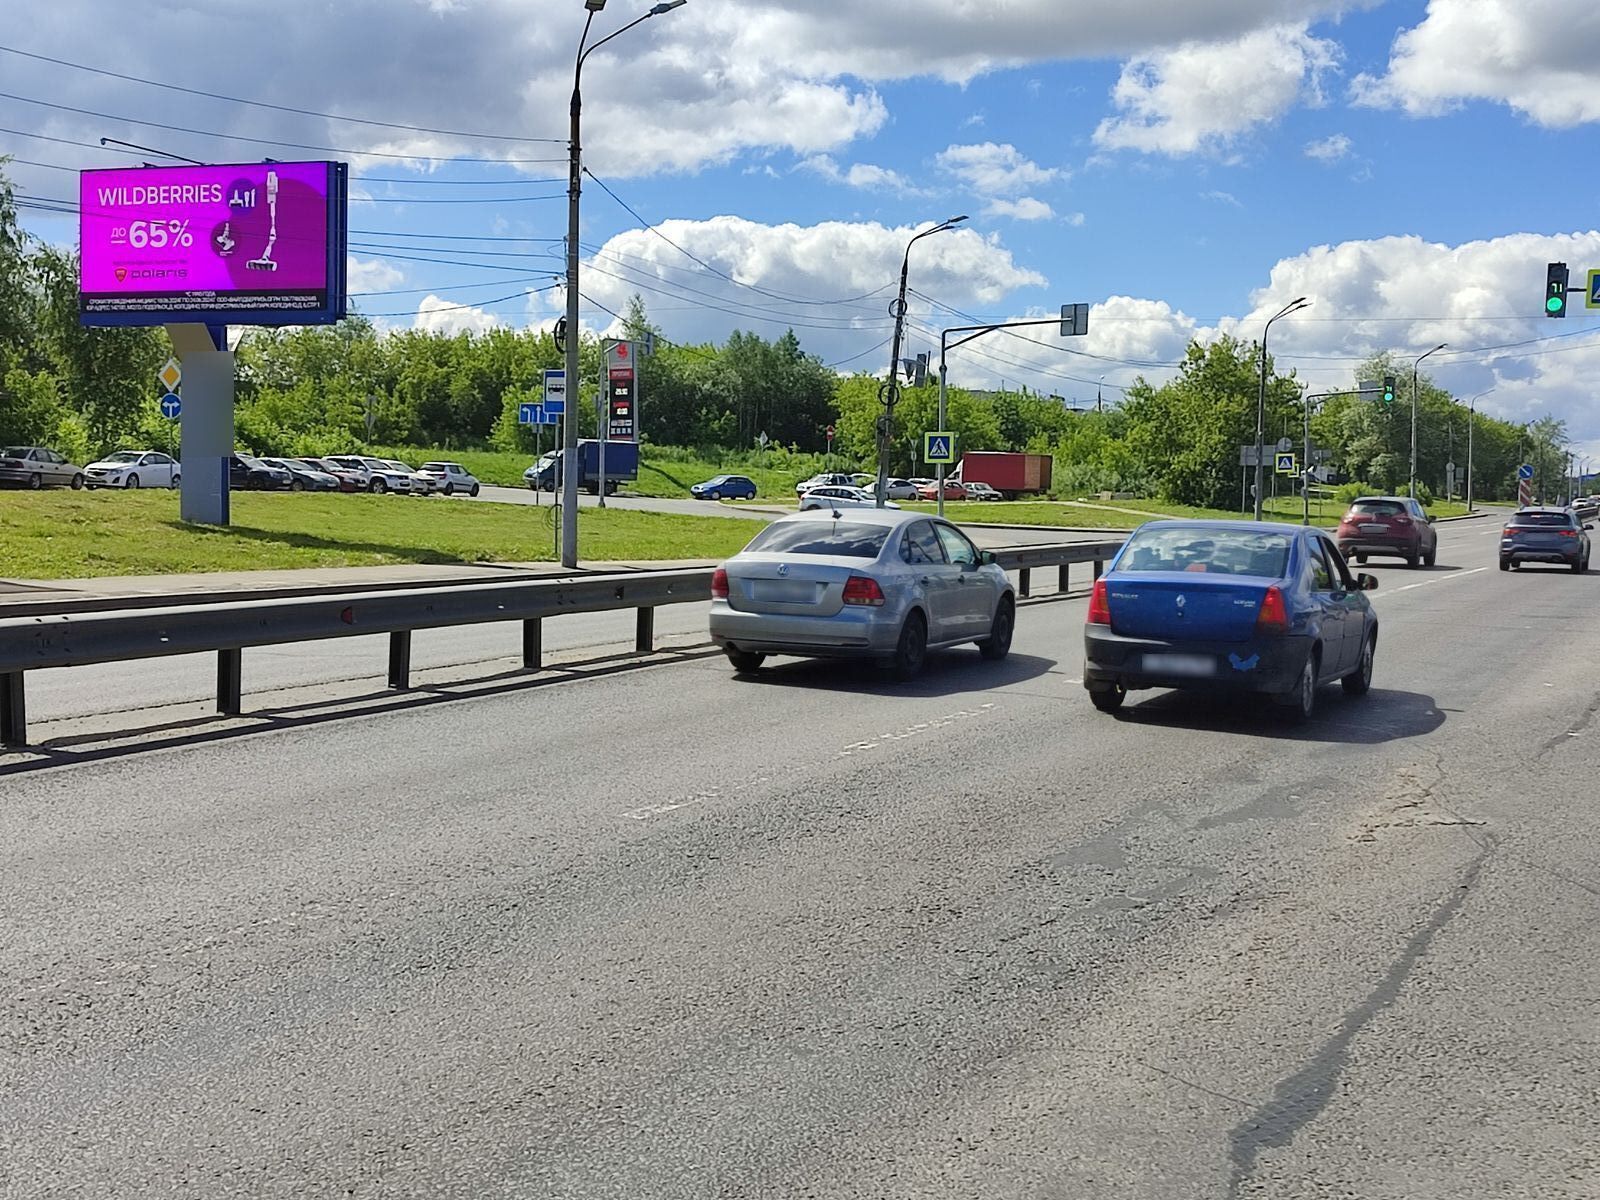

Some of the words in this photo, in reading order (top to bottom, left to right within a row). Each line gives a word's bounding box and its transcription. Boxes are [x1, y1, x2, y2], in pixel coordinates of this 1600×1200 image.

[98, 184, 222, 206] WILDBERRIES
[110, 227, 127, 239] ДО
[129, 219, 194, 248] 65%
[131, 268, 188, 280] polaris
